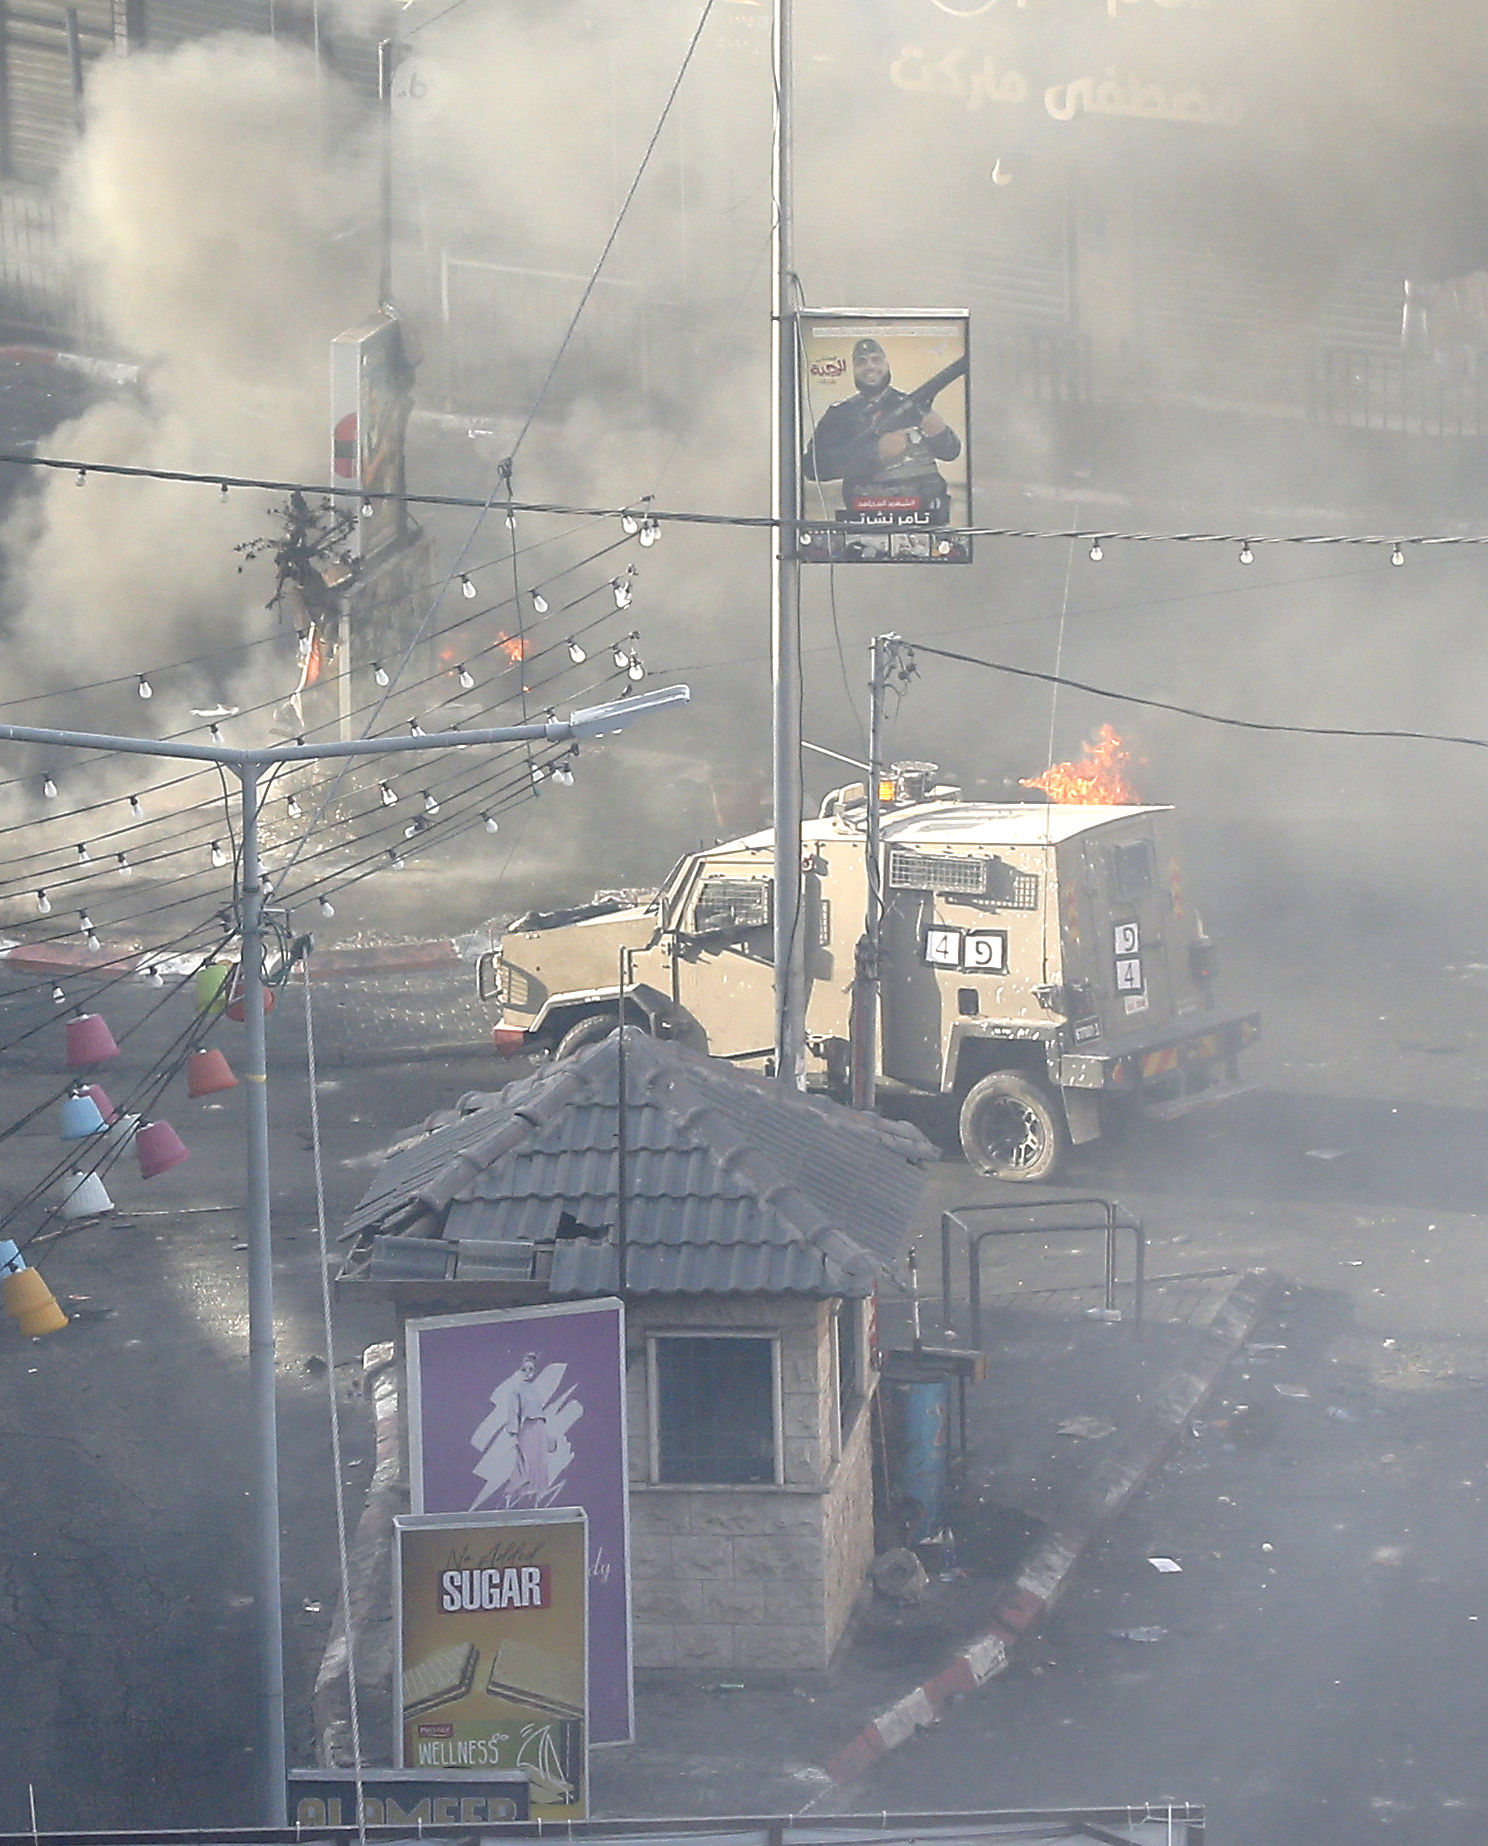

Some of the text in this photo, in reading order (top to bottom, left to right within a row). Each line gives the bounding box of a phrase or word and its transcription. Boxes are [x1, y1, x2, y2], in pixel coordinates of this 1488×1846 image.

[890, 43, 1028, 110] ماركت
[898, 512, 931, 526] تامر
[442, 1566, 542, 1612] SUGAR
[418, 1739, 499, 1766] WELLNESS
